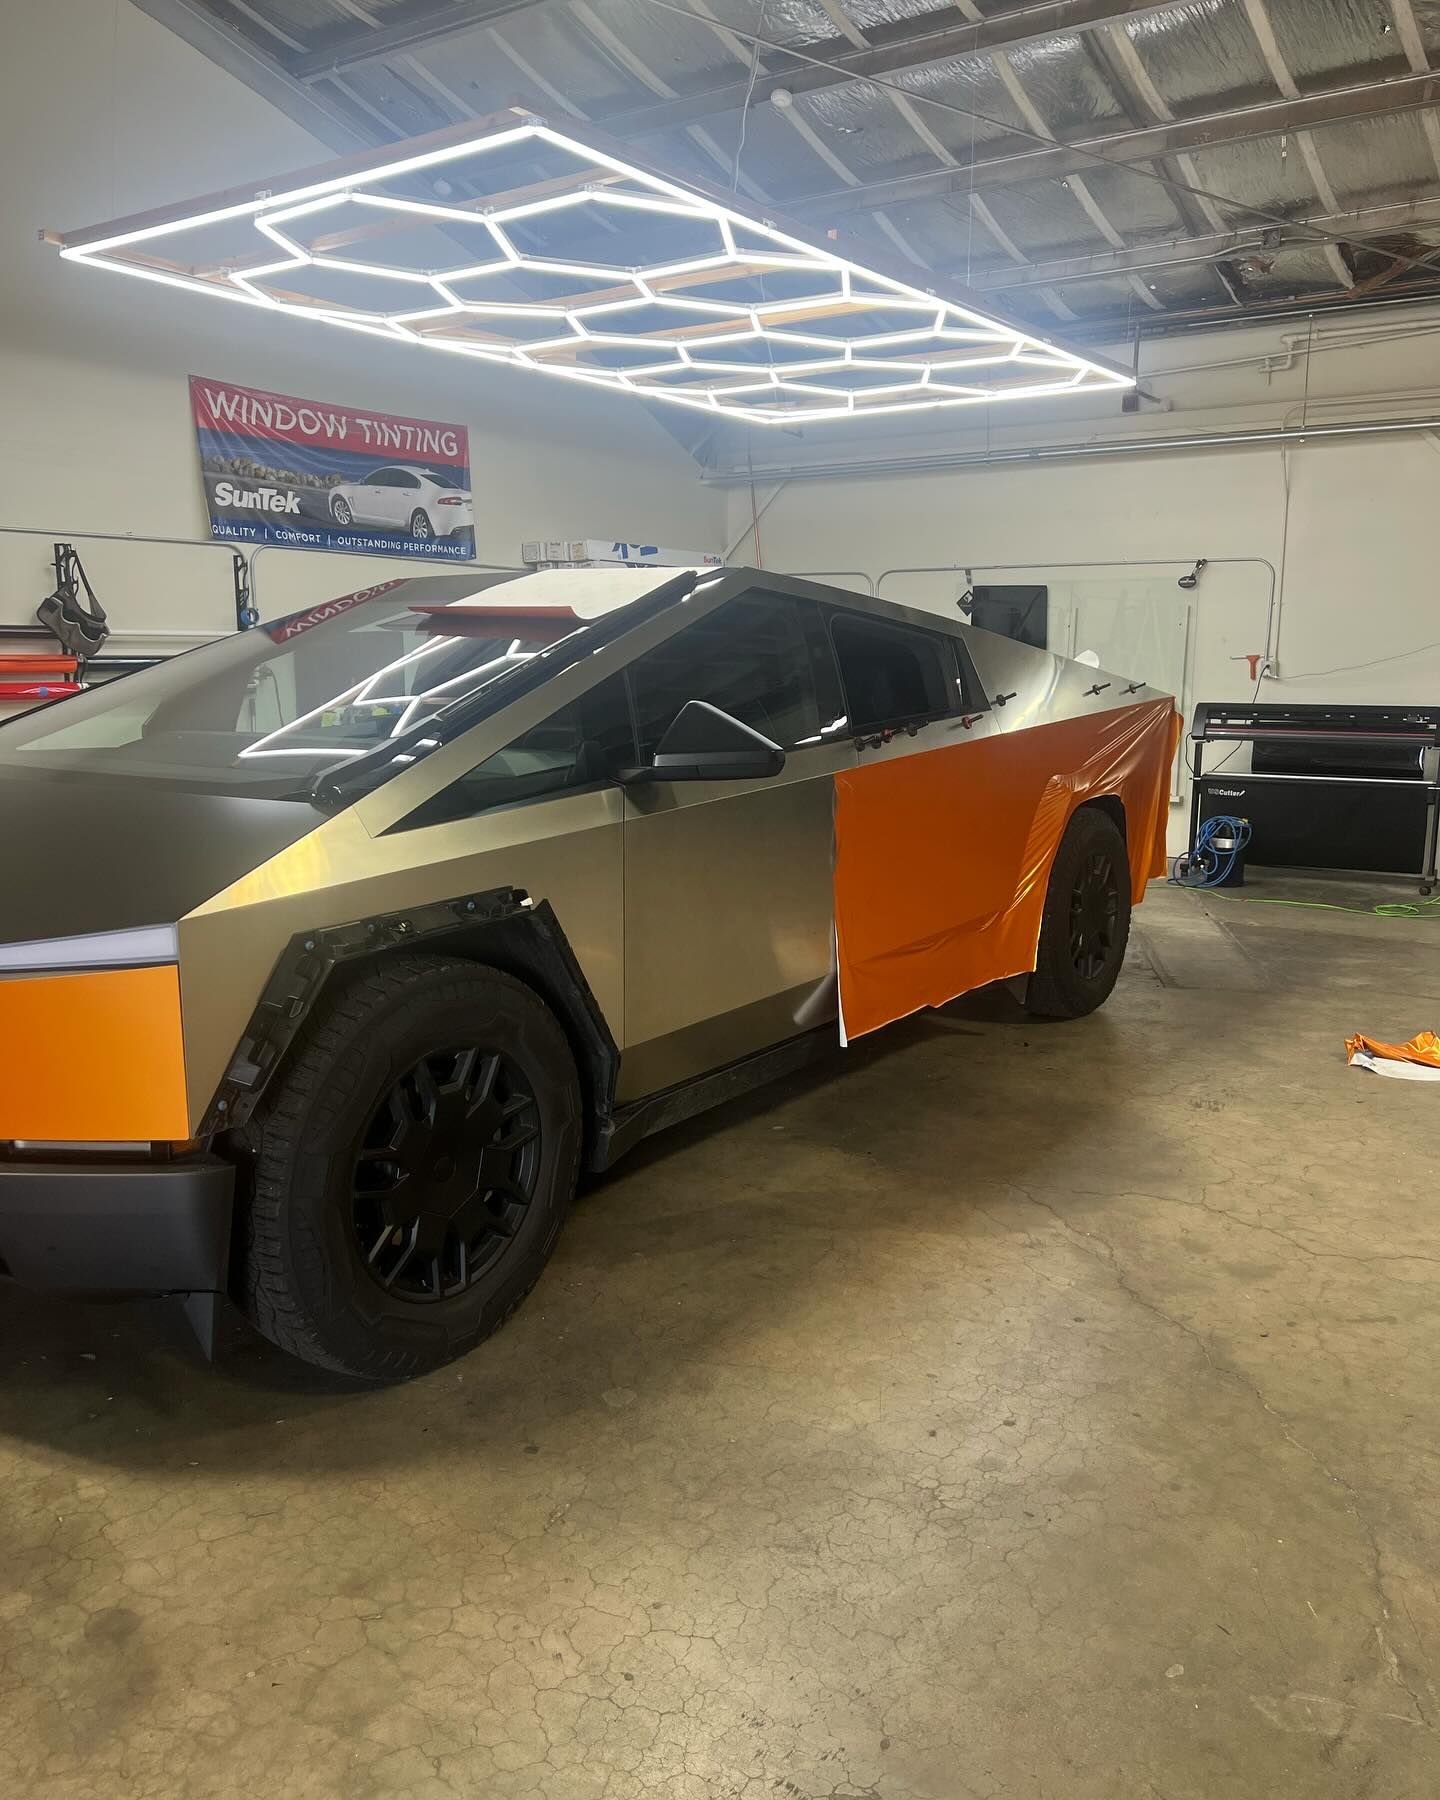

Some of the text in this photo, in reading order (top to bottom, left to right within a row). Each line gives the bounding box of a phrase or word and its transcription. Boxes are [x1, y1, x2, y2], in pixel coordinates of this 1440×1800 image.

[204, 388, 458, 457] WINDOW TINTING
[214, 482, 301, 514] SunTek
[212, 524, 467, 555] QUALITY COMFORT OUTSTANDING PERFORMANCE
